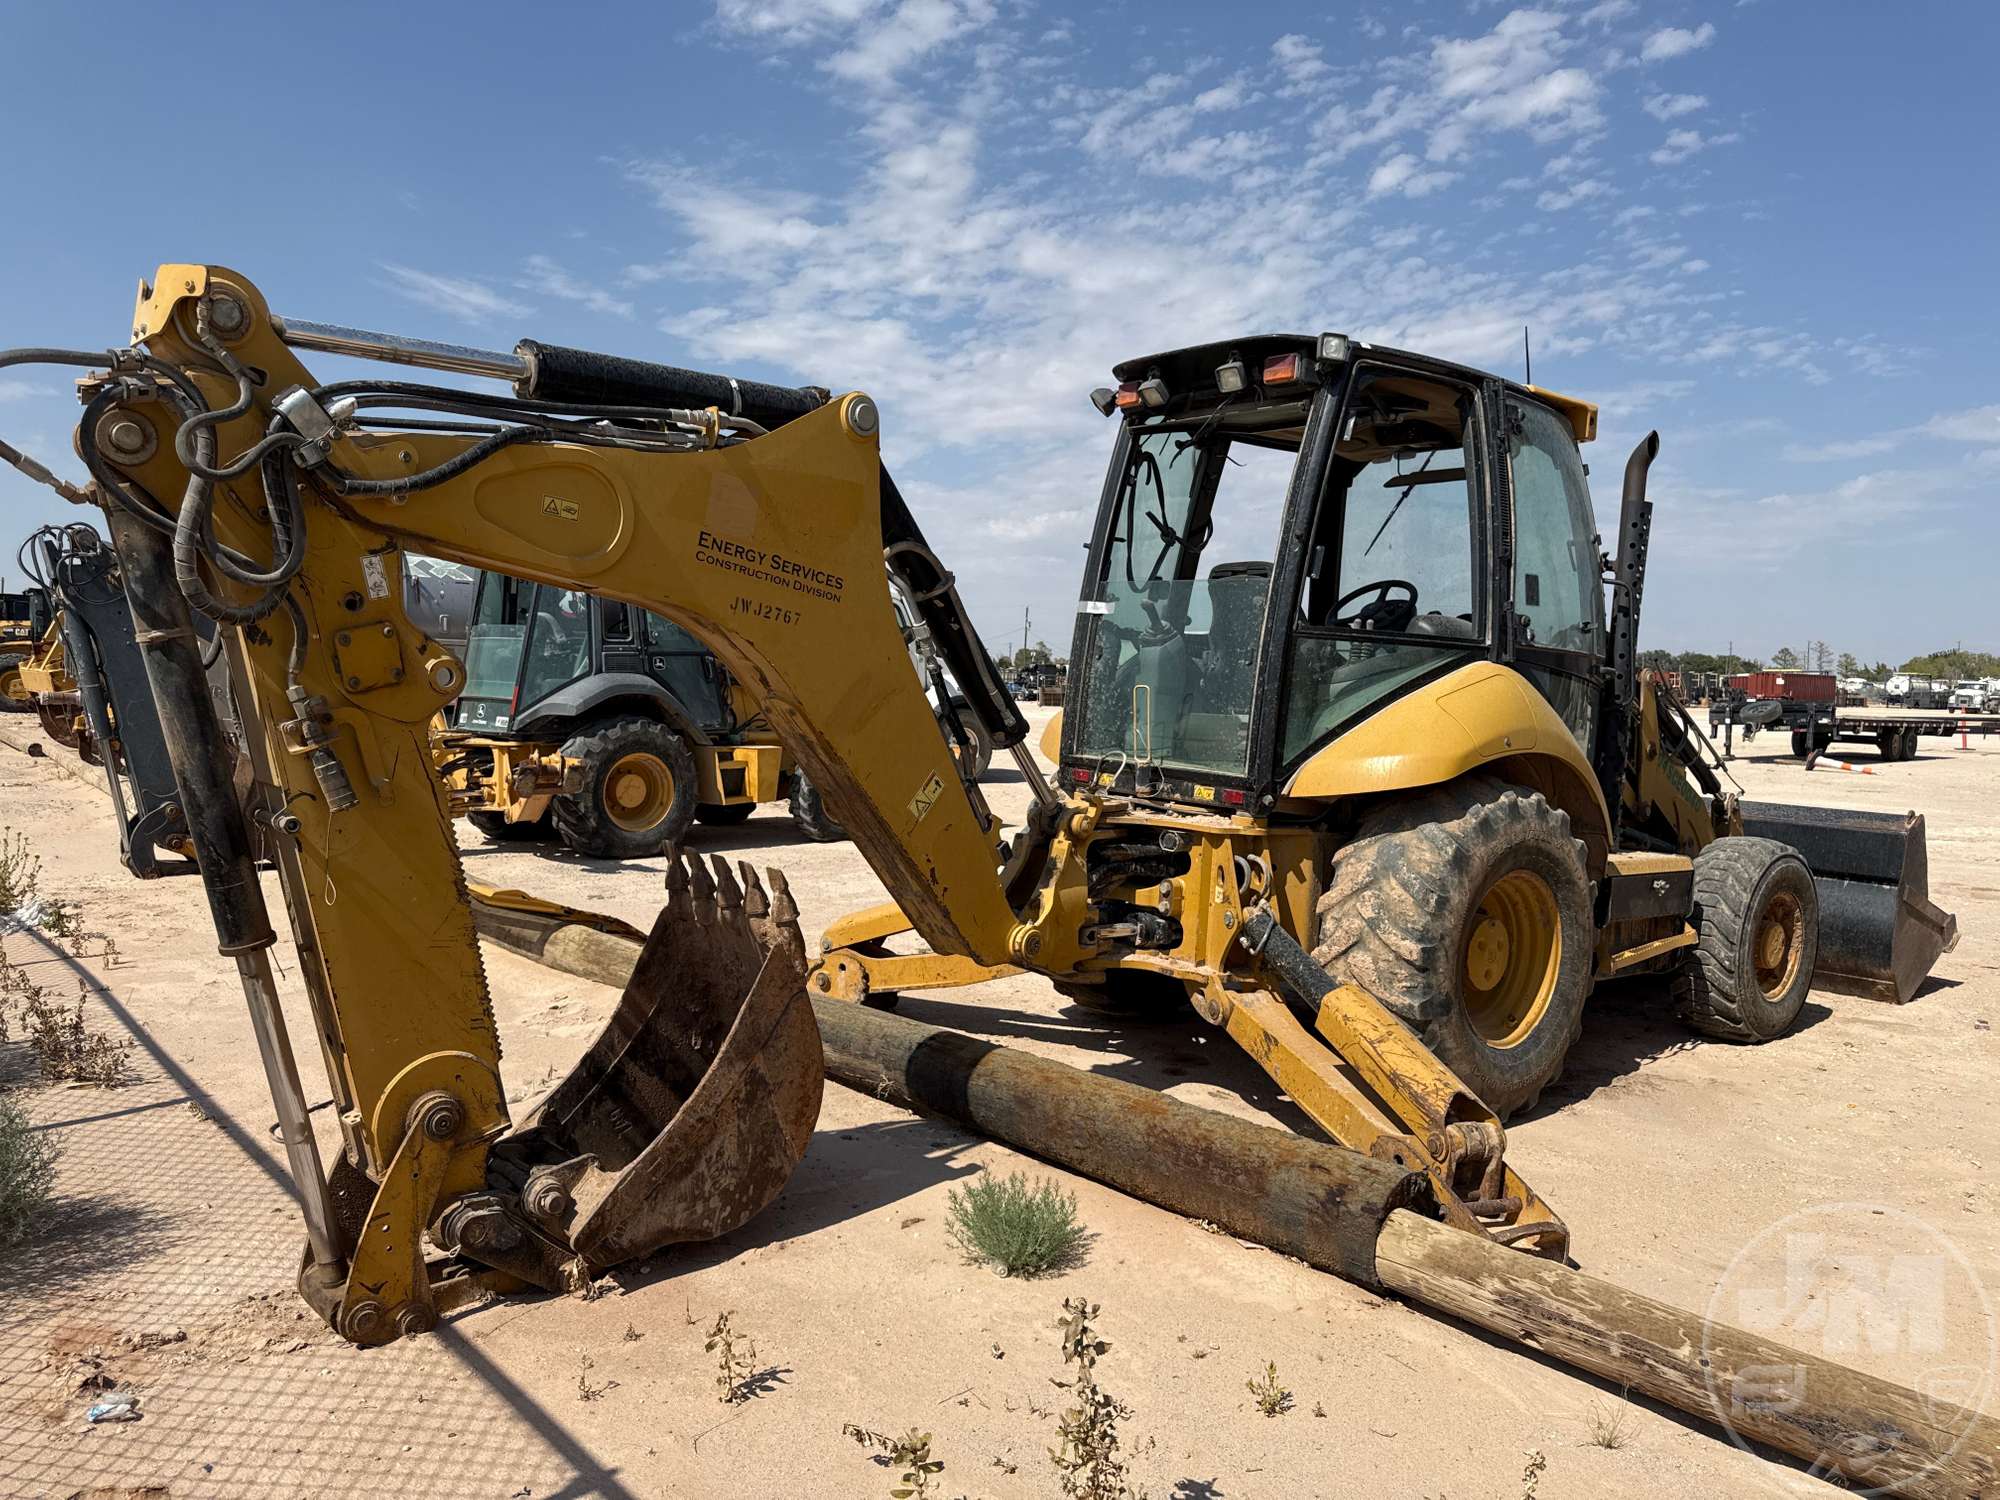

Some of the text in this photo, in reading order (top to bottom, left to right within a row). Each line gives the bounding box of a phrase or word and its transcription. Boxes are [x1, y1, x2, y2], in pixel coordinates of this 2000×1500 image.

[696, 550, 841, 603] CONSTRUCTION DIVISION
[698, 531, 844, 590] ENERGY SERVICES
[730, 597, 802, 625] JWJ2767
[15, 628, 29, 636] CAT
